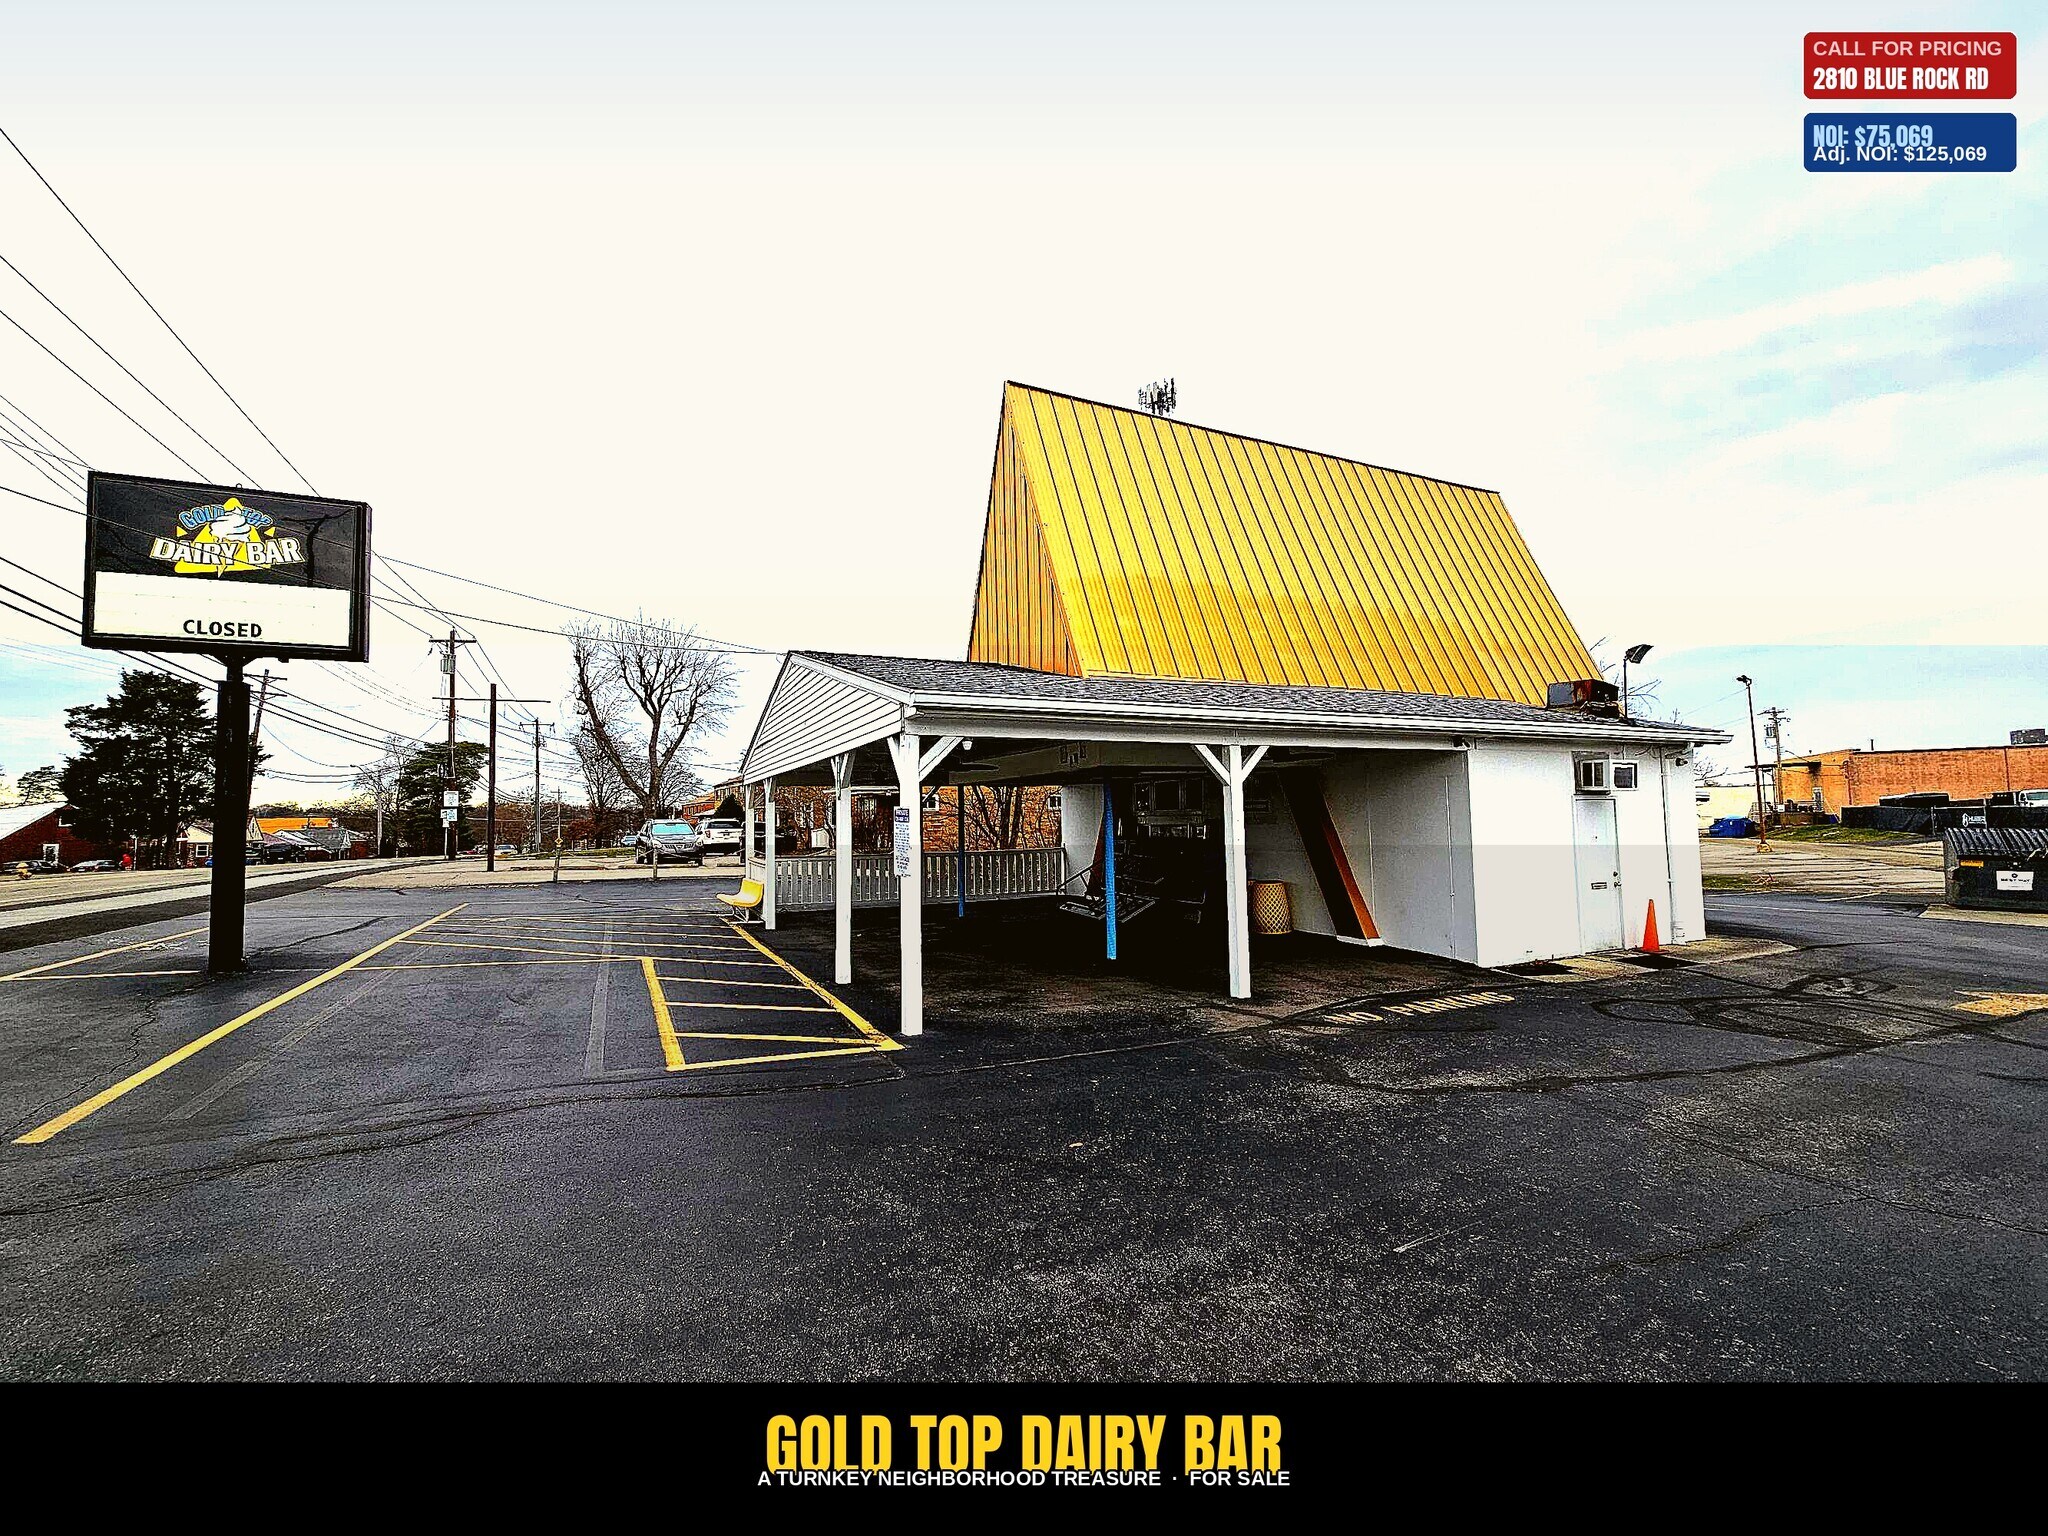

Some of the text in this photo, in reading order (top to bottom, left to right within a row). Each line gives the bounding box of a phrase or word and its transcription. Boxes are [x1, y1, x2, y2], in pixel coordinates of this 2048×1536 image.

[180, 505, 272, 529] GOLD TOP
[150, 537, 305, 565] DAIRY BAR
[183, 619, 262, 638] CLOSED
[1323, 991, 1516, 1025] NO PARKING
